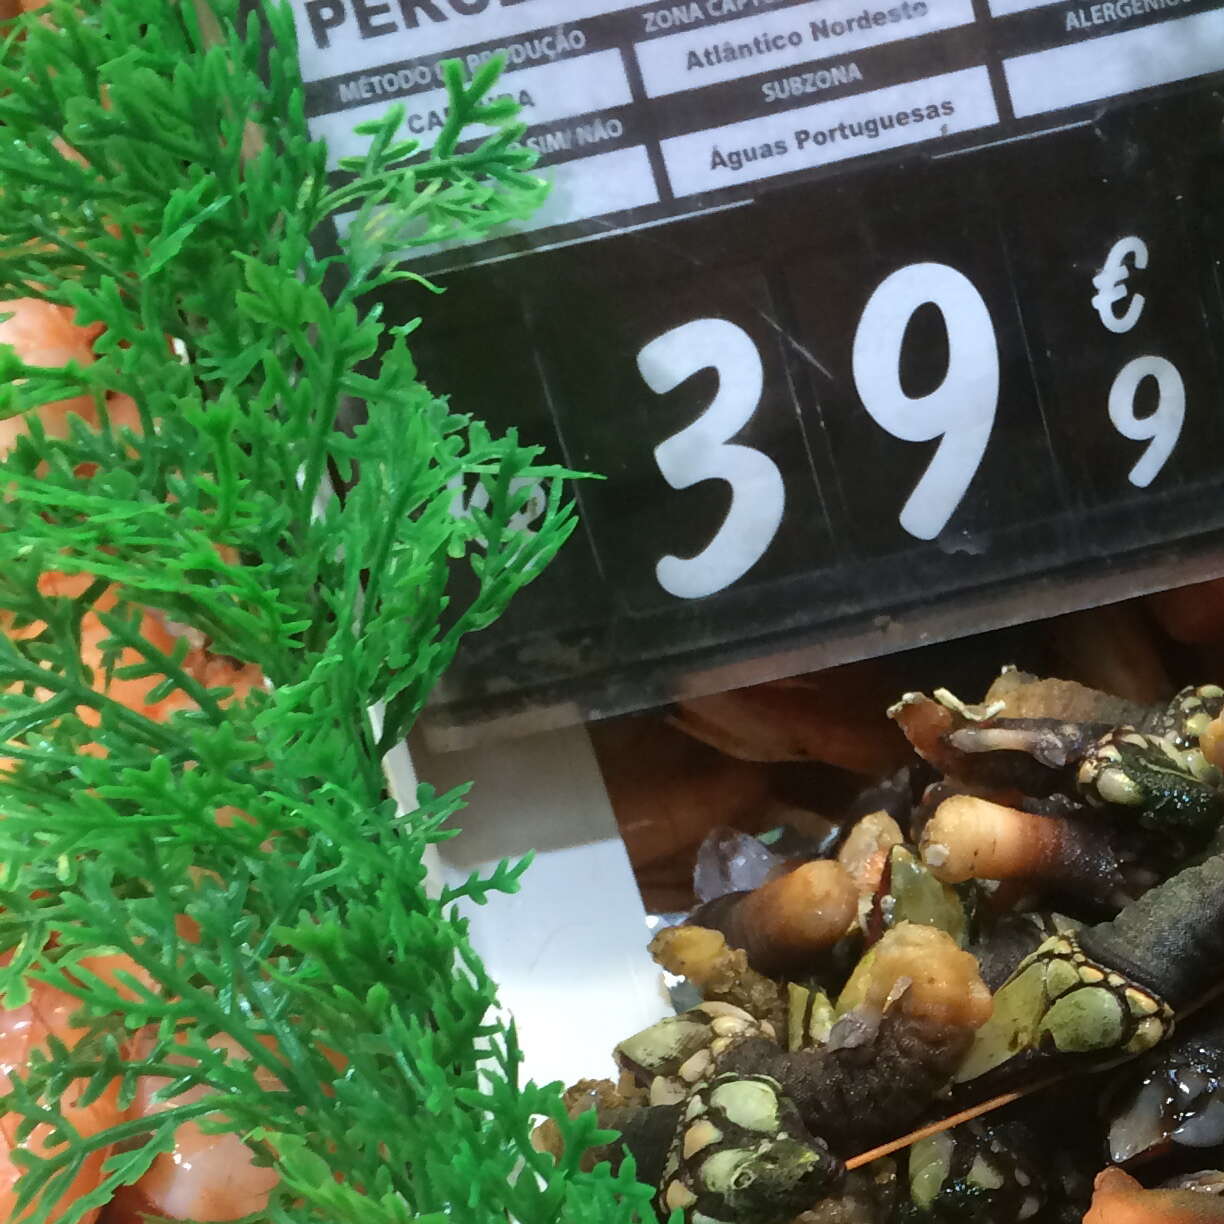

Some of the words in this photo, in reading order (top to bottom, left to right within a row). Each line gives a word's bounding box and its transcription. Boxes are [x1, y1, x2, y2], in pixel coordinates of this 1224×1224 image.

[641, 2, 704, 32] ZONA
[687, 30, 802, 70] Atlântico
[809, 2, 928, 42] Nordeste
[338, 66, 431, 102] MÉTODO
[761, 63, 863, 102] SUBZONA
[710, 138, 789, 171] Águas
[794, 99, 955, 150] Portuguesas
